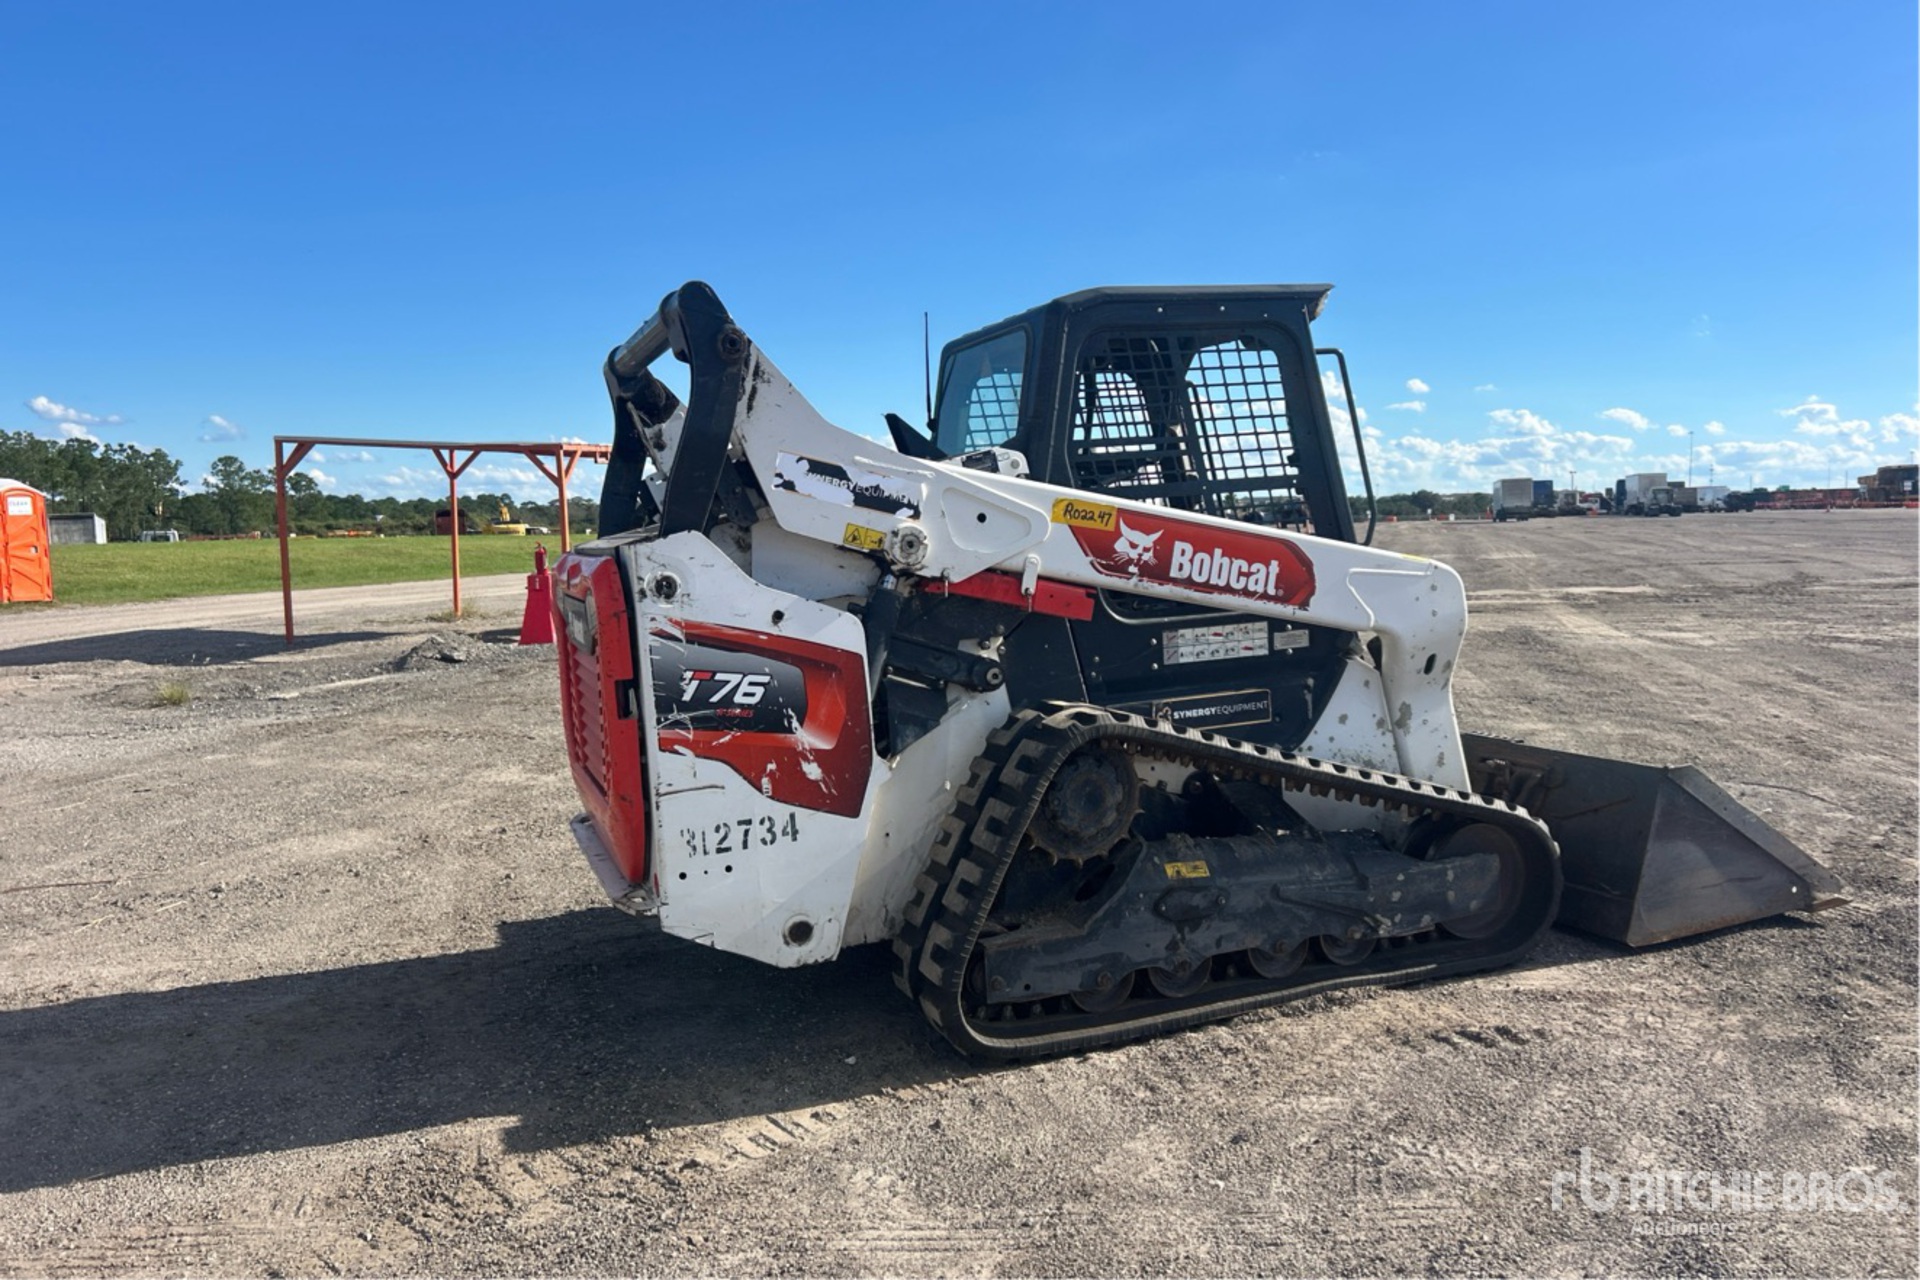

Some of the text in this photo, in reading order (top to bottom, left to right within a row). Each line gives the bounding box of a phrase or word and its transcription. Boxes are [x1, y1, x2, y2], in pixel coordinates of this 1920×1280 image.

[1169, 540, 1280, 597] Bobcat
[680, 669, 772, 706] T76
[680, 812, 799, 858] 312734
